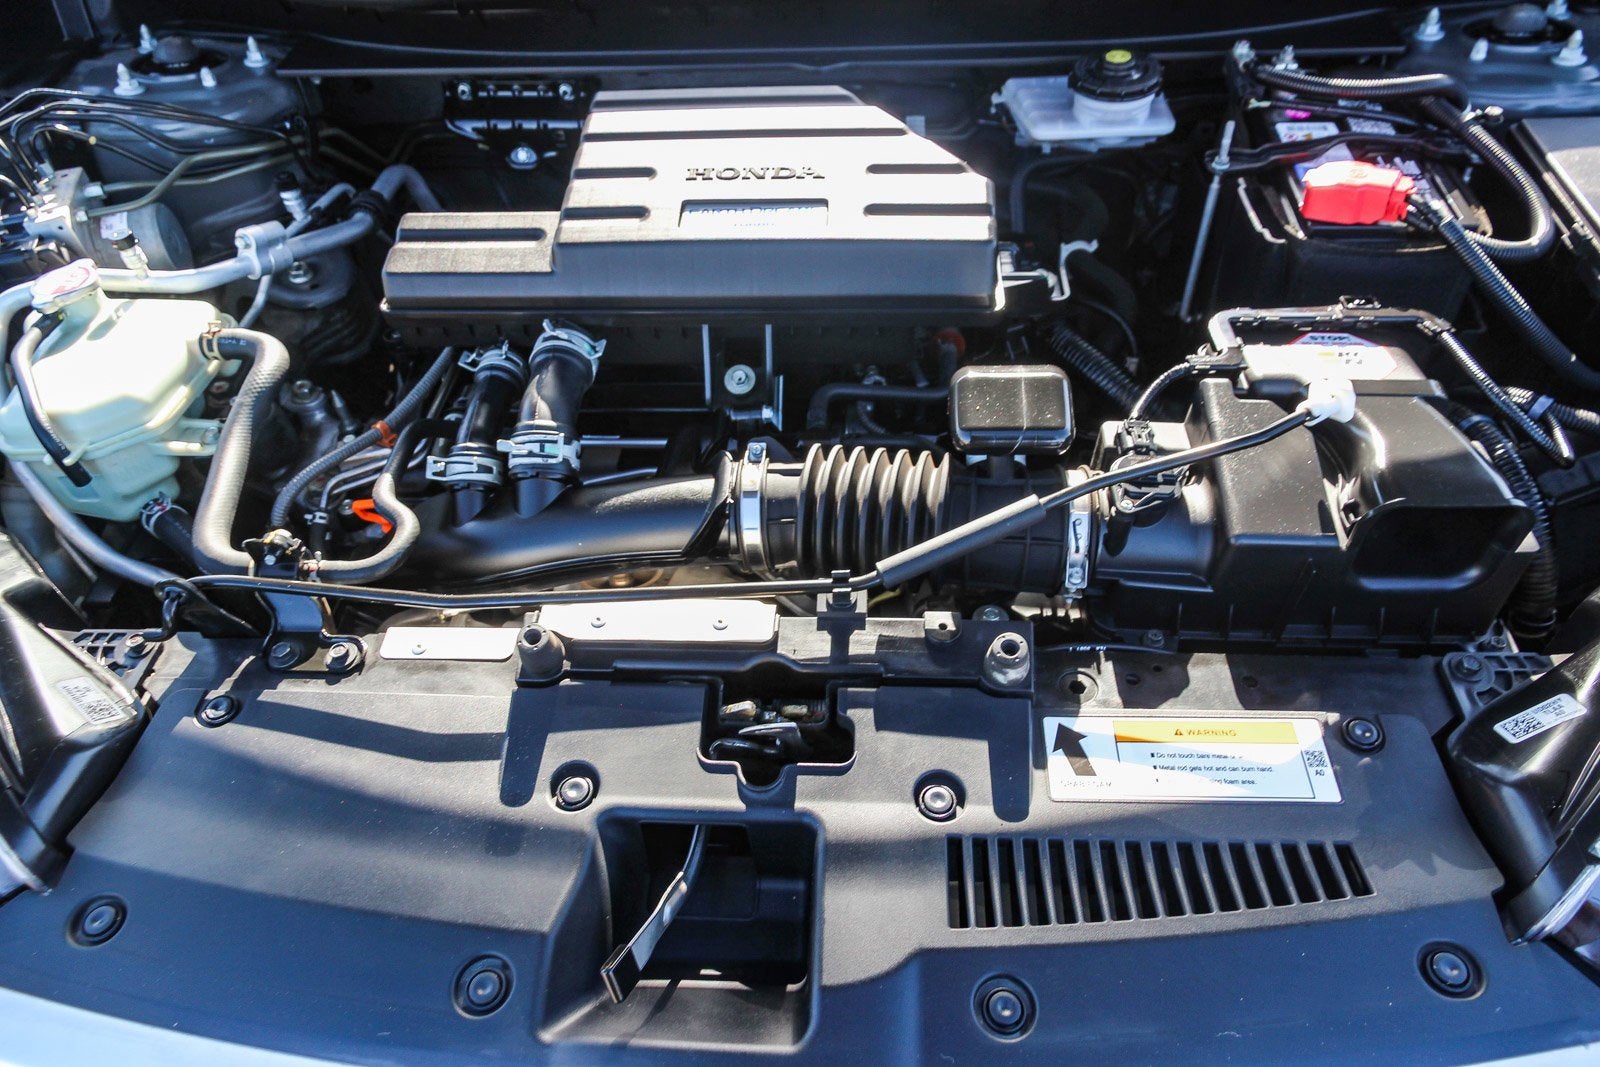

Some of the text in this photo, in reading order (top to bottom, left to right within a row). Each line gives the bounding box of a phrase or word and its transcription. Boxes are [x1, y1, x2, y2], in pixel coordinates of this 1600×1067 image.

[685, 166, 826, 181] HONDA
[1186, 728, 1237, 737] WARNING
[1156, 751, 1166, 759] Do
[1167, 751, 1177, 759] not
[1177, 751, 1196, 759] touch
[1189, 765, 1203, 773] gets
